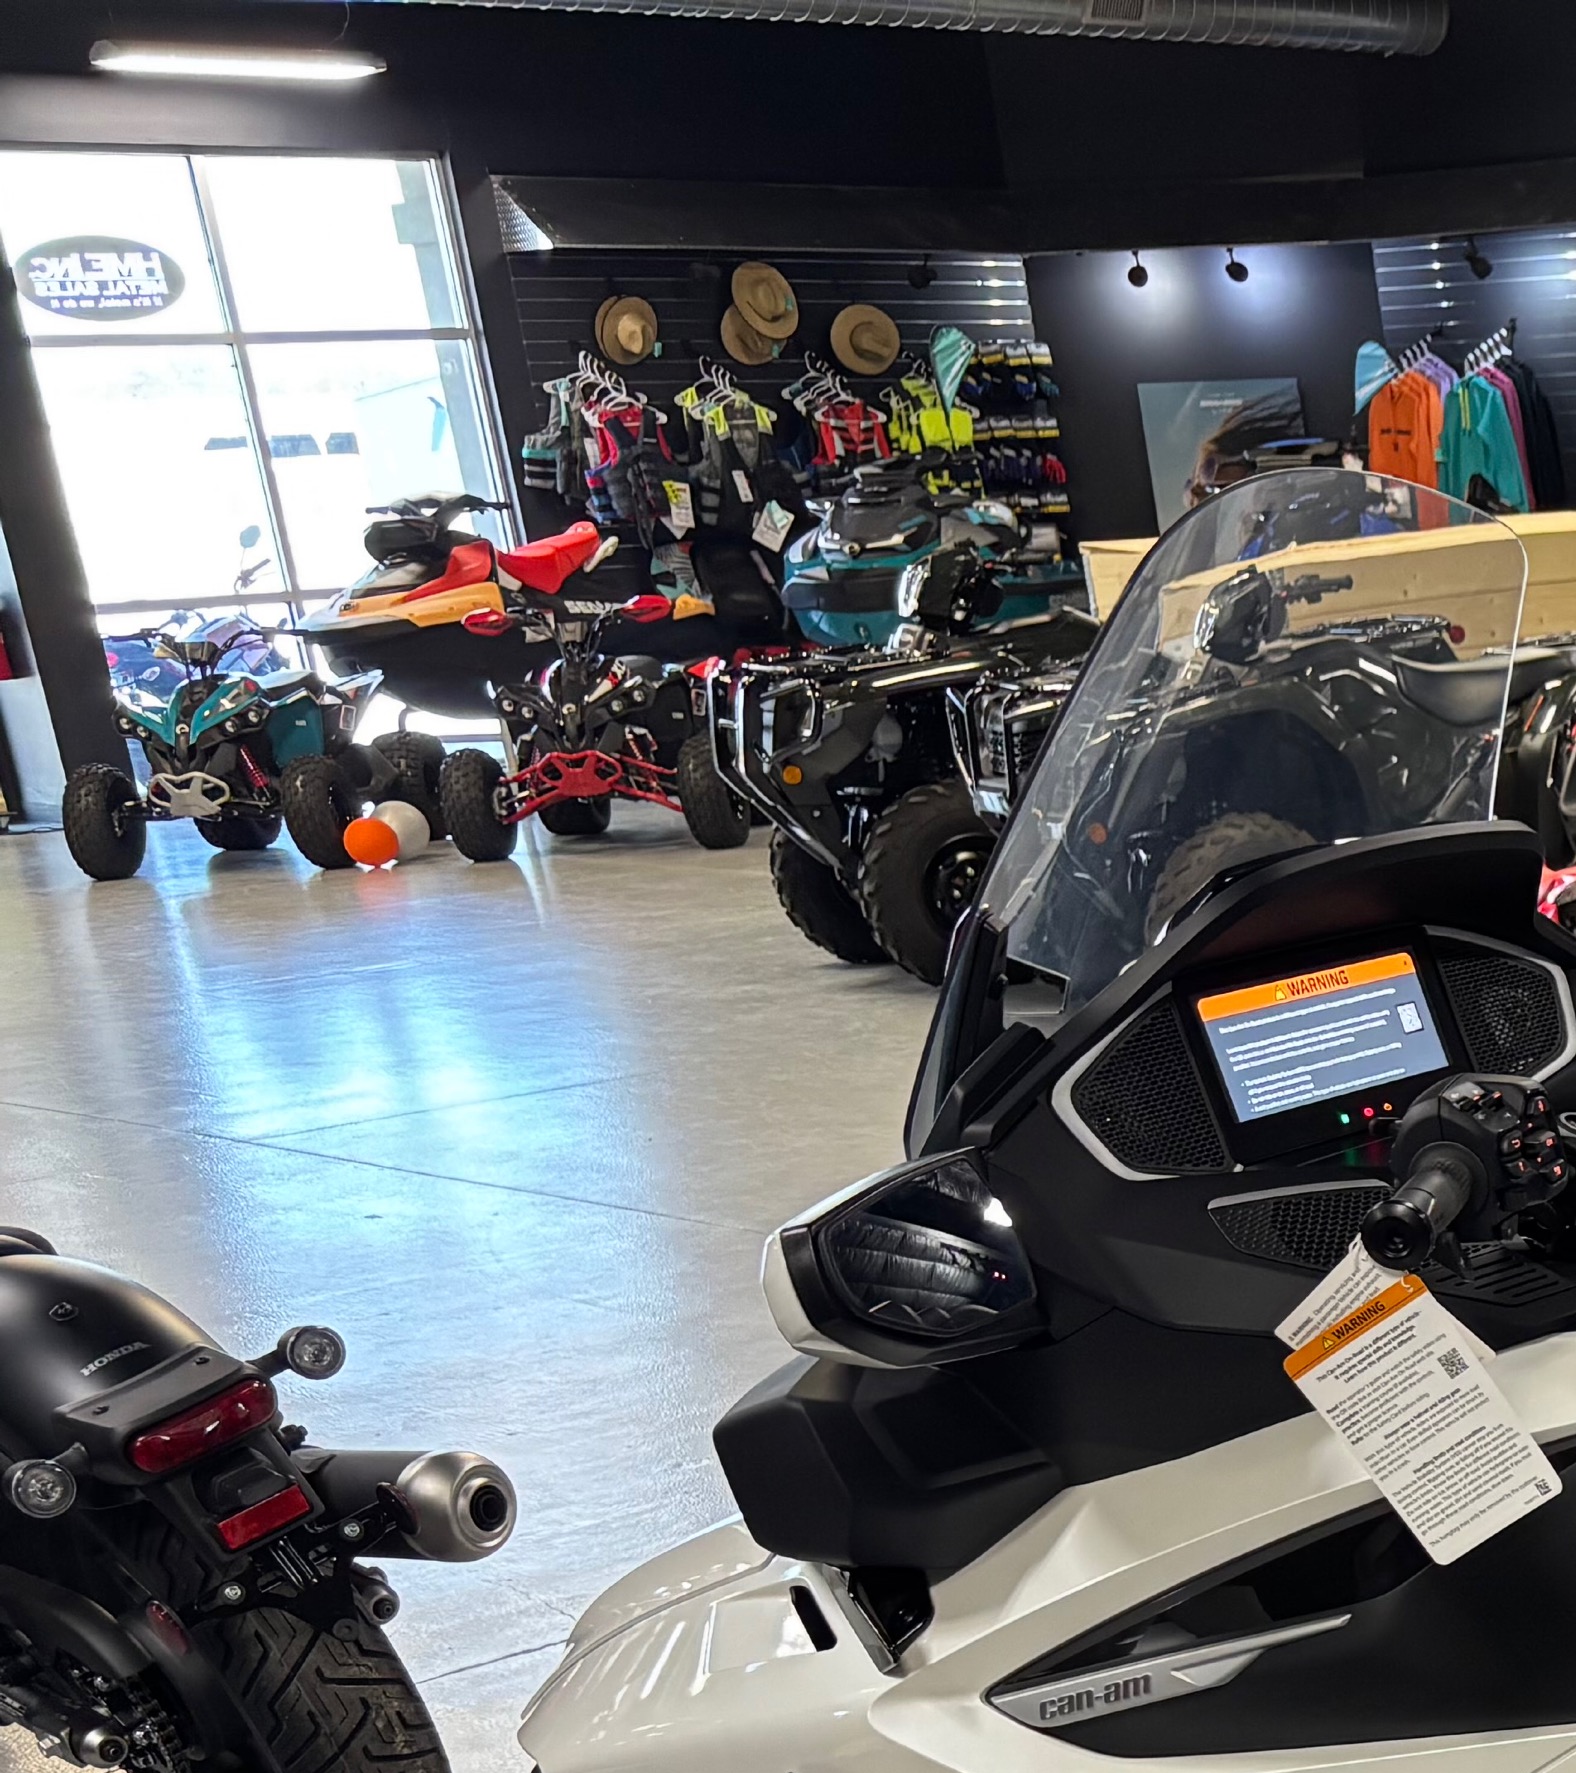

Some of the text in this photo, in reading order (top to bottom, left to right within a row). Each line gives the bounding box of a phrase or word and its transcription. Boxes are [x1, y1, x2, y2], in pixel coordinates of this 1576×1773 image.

[1286, 970, 1350, 997] WARNING
[1331, 1300, 1387, 1341] WARNING
[79, 1341, 152, 1377] HONDA
[1039, 1671, 1153, 1721] can-am
